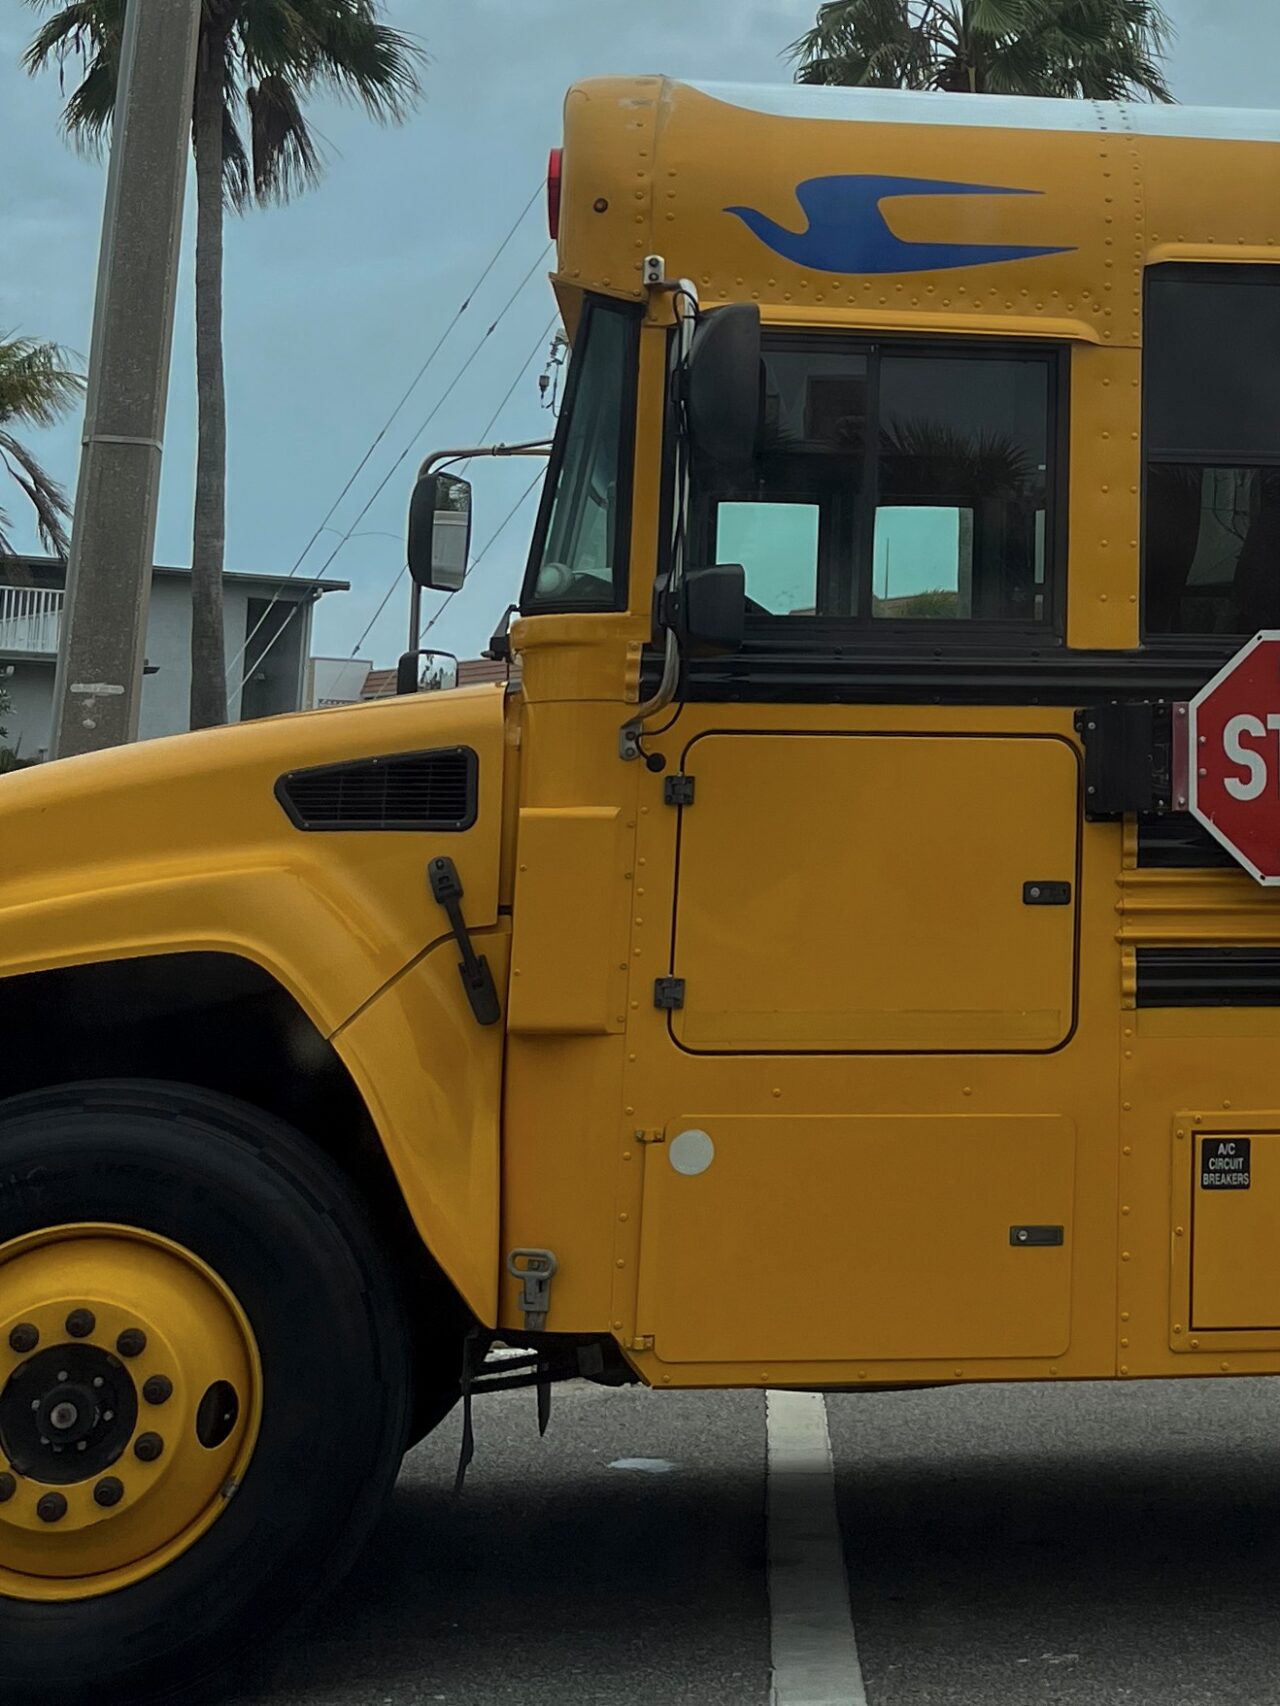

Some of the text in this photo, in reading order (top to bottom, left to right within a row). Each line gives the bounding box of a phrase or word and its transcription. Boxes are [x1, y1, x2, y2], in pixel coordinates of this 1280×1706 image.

[1217, 1142, 1236, 1155] A/C
[1208, 1157, 1244, 1170] CIRCUIT
[1202, 1172, 1249, 1185] BREAKERS
